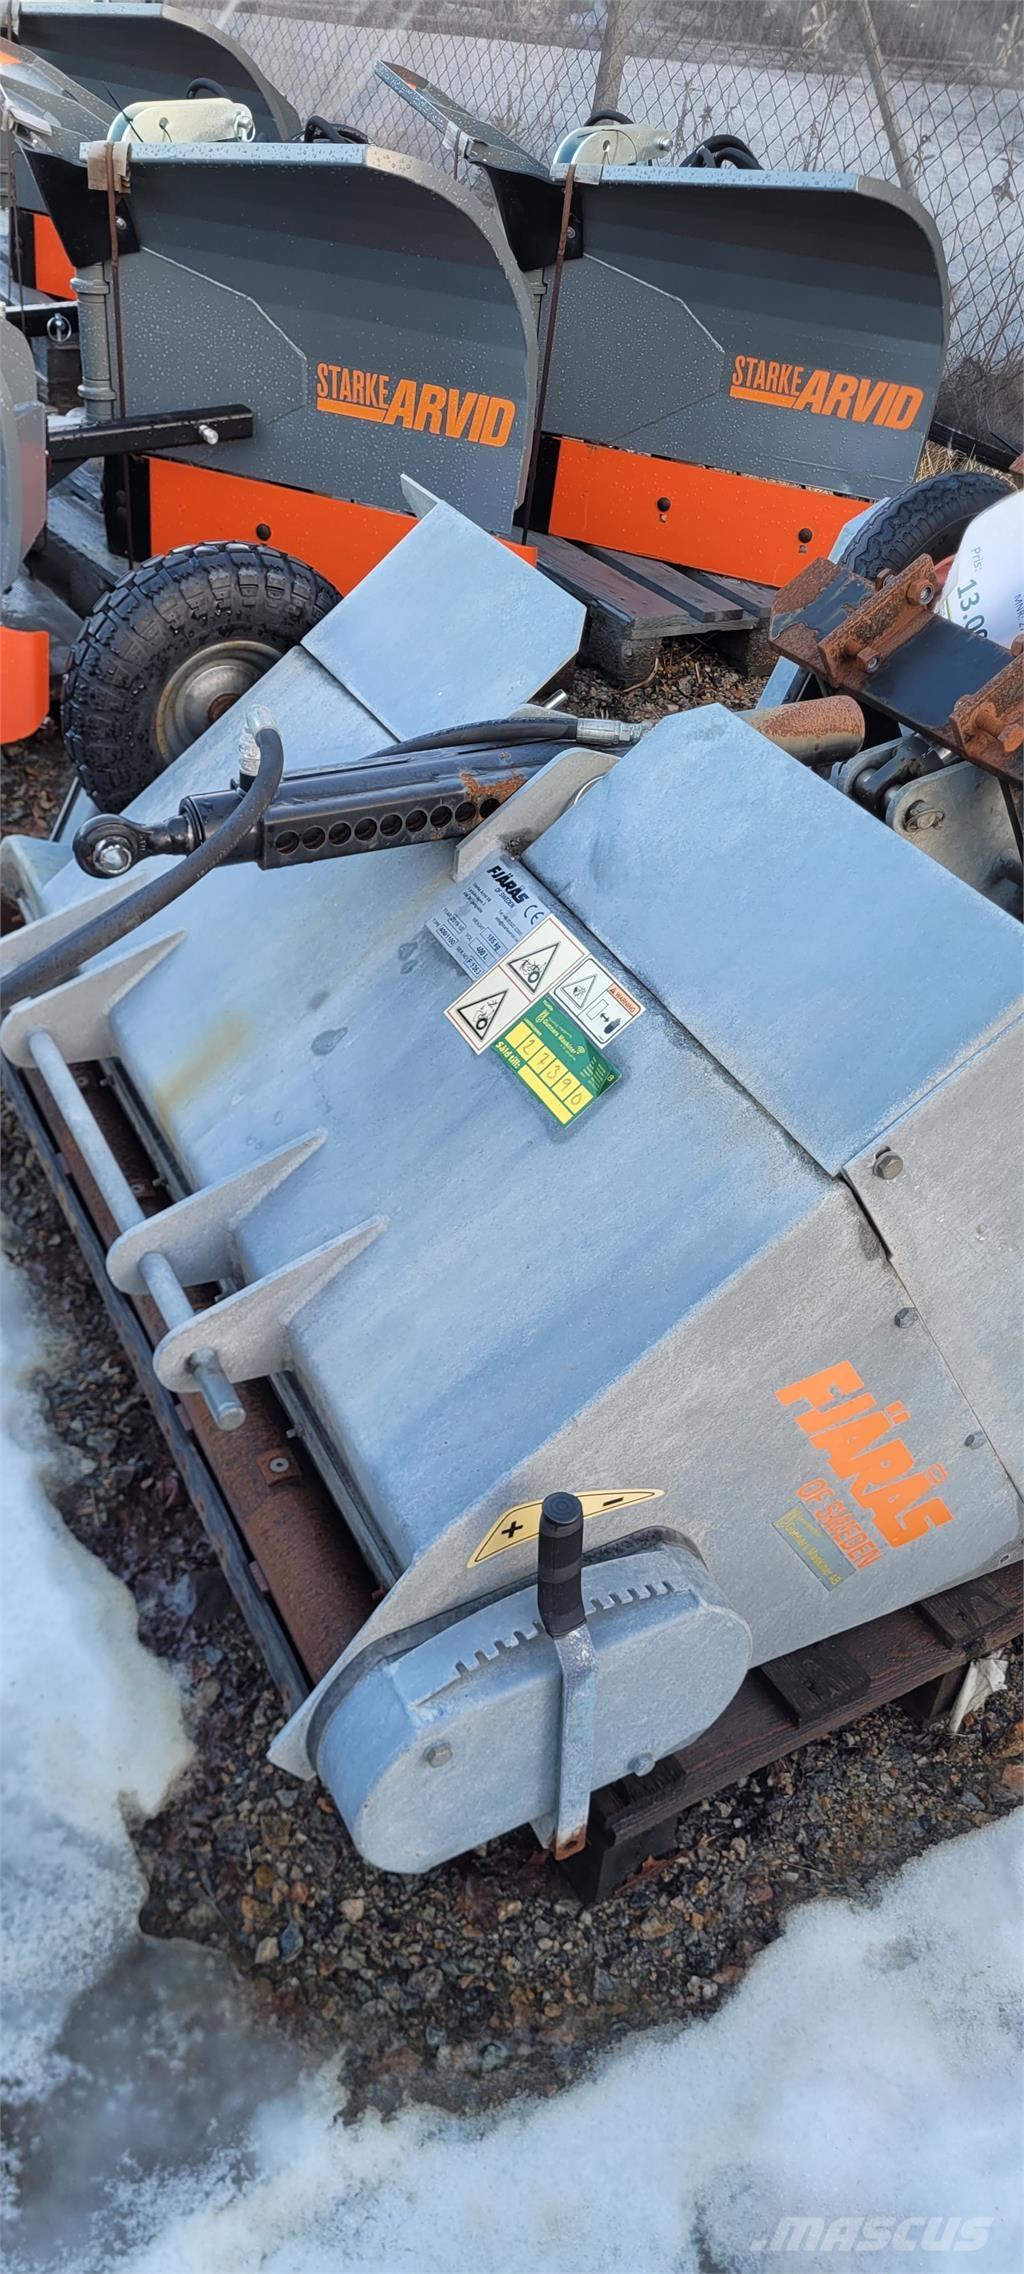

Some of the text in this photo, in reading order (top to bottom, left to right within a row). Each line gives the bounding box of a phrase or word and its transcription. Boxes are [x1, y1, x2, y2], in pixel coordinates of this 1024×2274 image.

[316, 362, 516, 448] STARKE ARVID
[732, 355, 925, 431] STARKE ARVID
[970, 547, 983, 572] Pris:
[613, 992, 636, 1014] WARNING
[774, 1359, 954, 1549] FJÄRÅS
[795, 1477, 836, 1505] OF
[815, 1499, 887, 1570] SWEDEN
